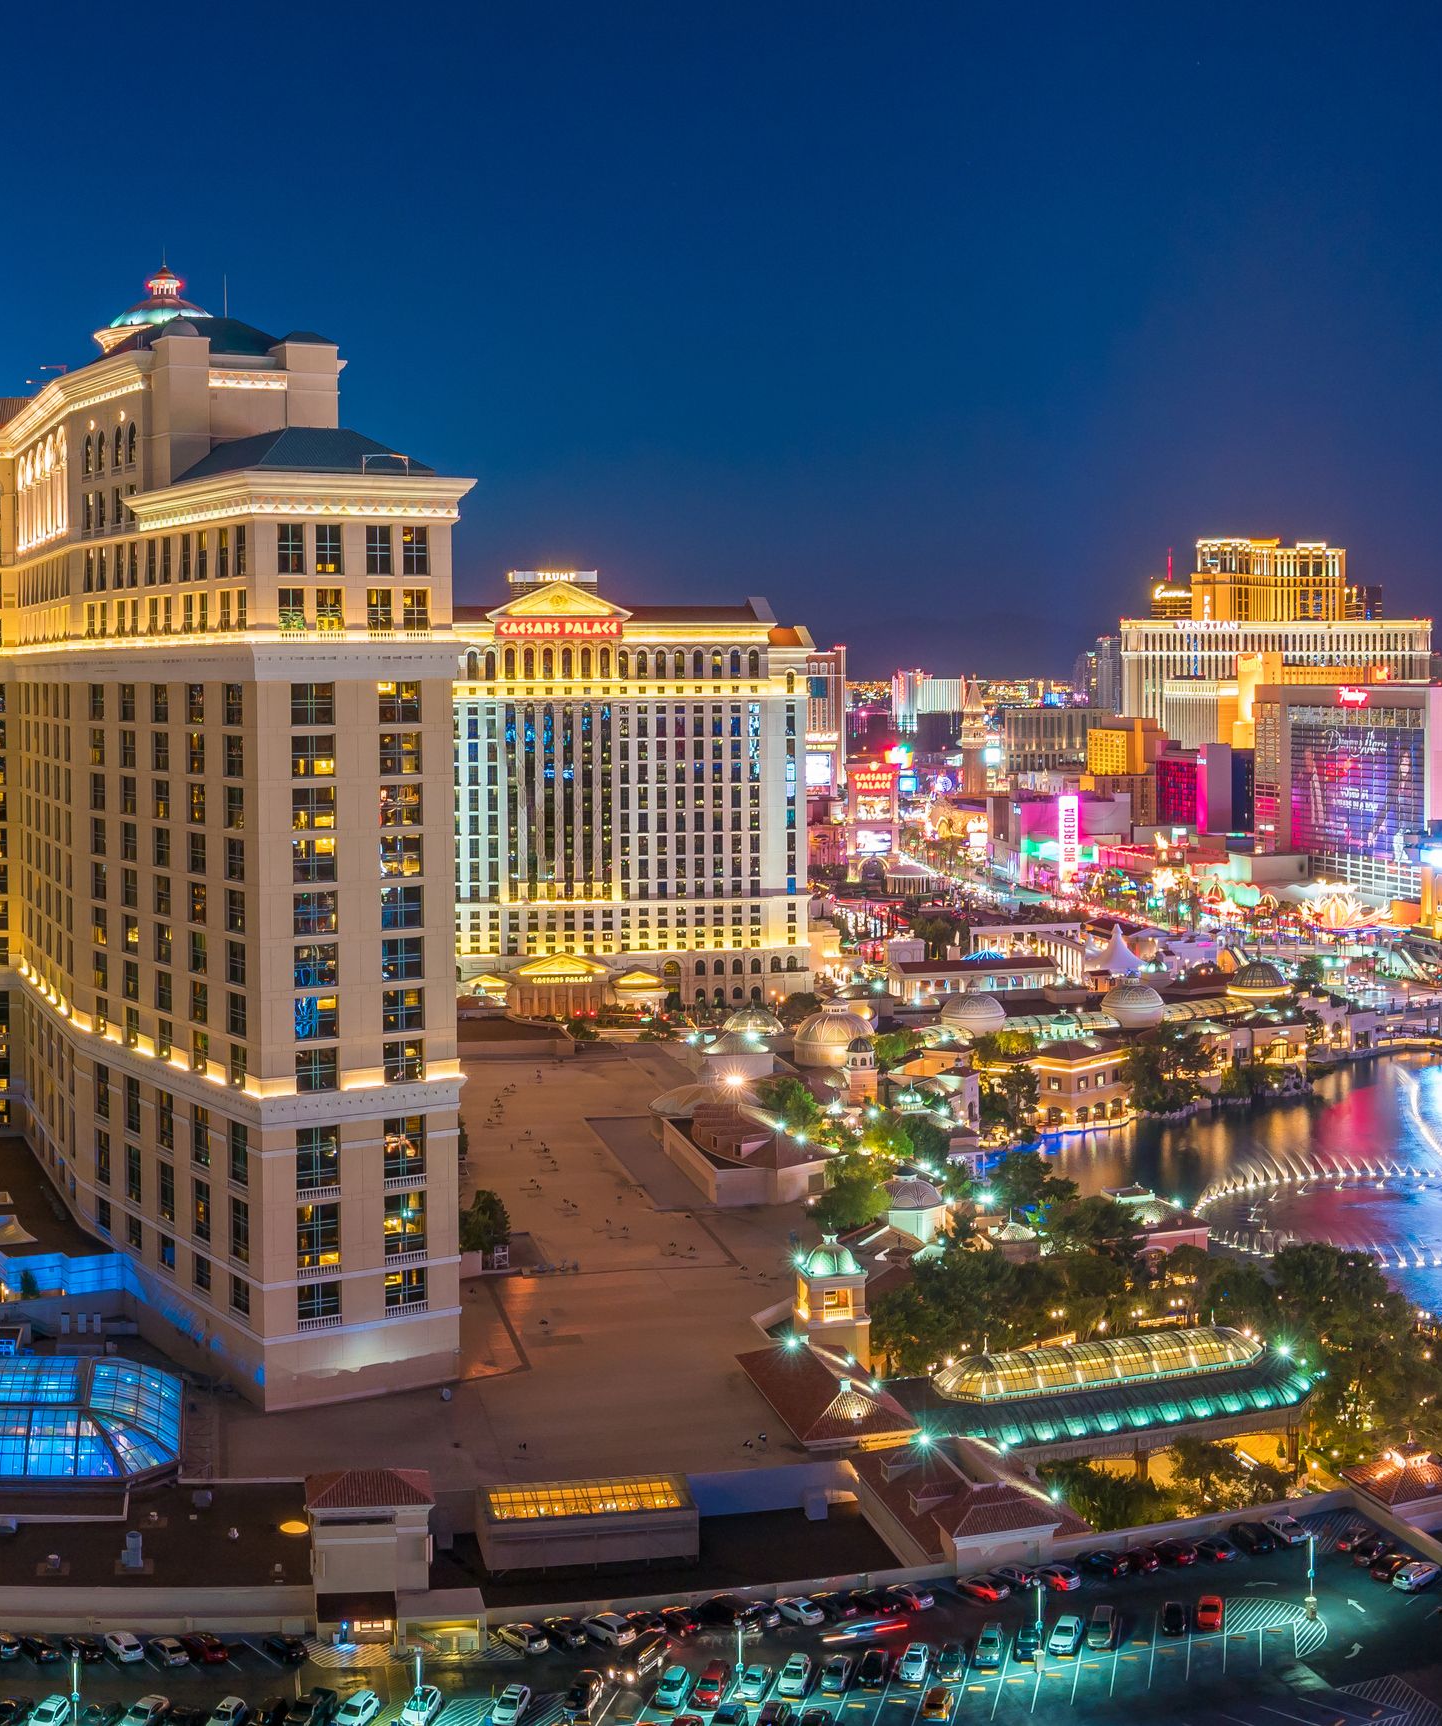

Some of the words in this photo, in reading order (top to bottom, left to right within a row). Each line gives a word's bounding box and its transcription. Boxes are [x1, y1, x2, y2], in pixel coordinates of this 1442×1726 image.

[537, 572, 576, 581] TRUMP
[500, 622, 561, 635] CAESARS
[564, 622, 618, 635] PALACE
[1175, 620, 1239, 631] VENETIAN
[854, 773, 893, 782] CAESARS
[856, 781, 891, 790] PALACE
[1063, 847, 1076, 863] BIG
